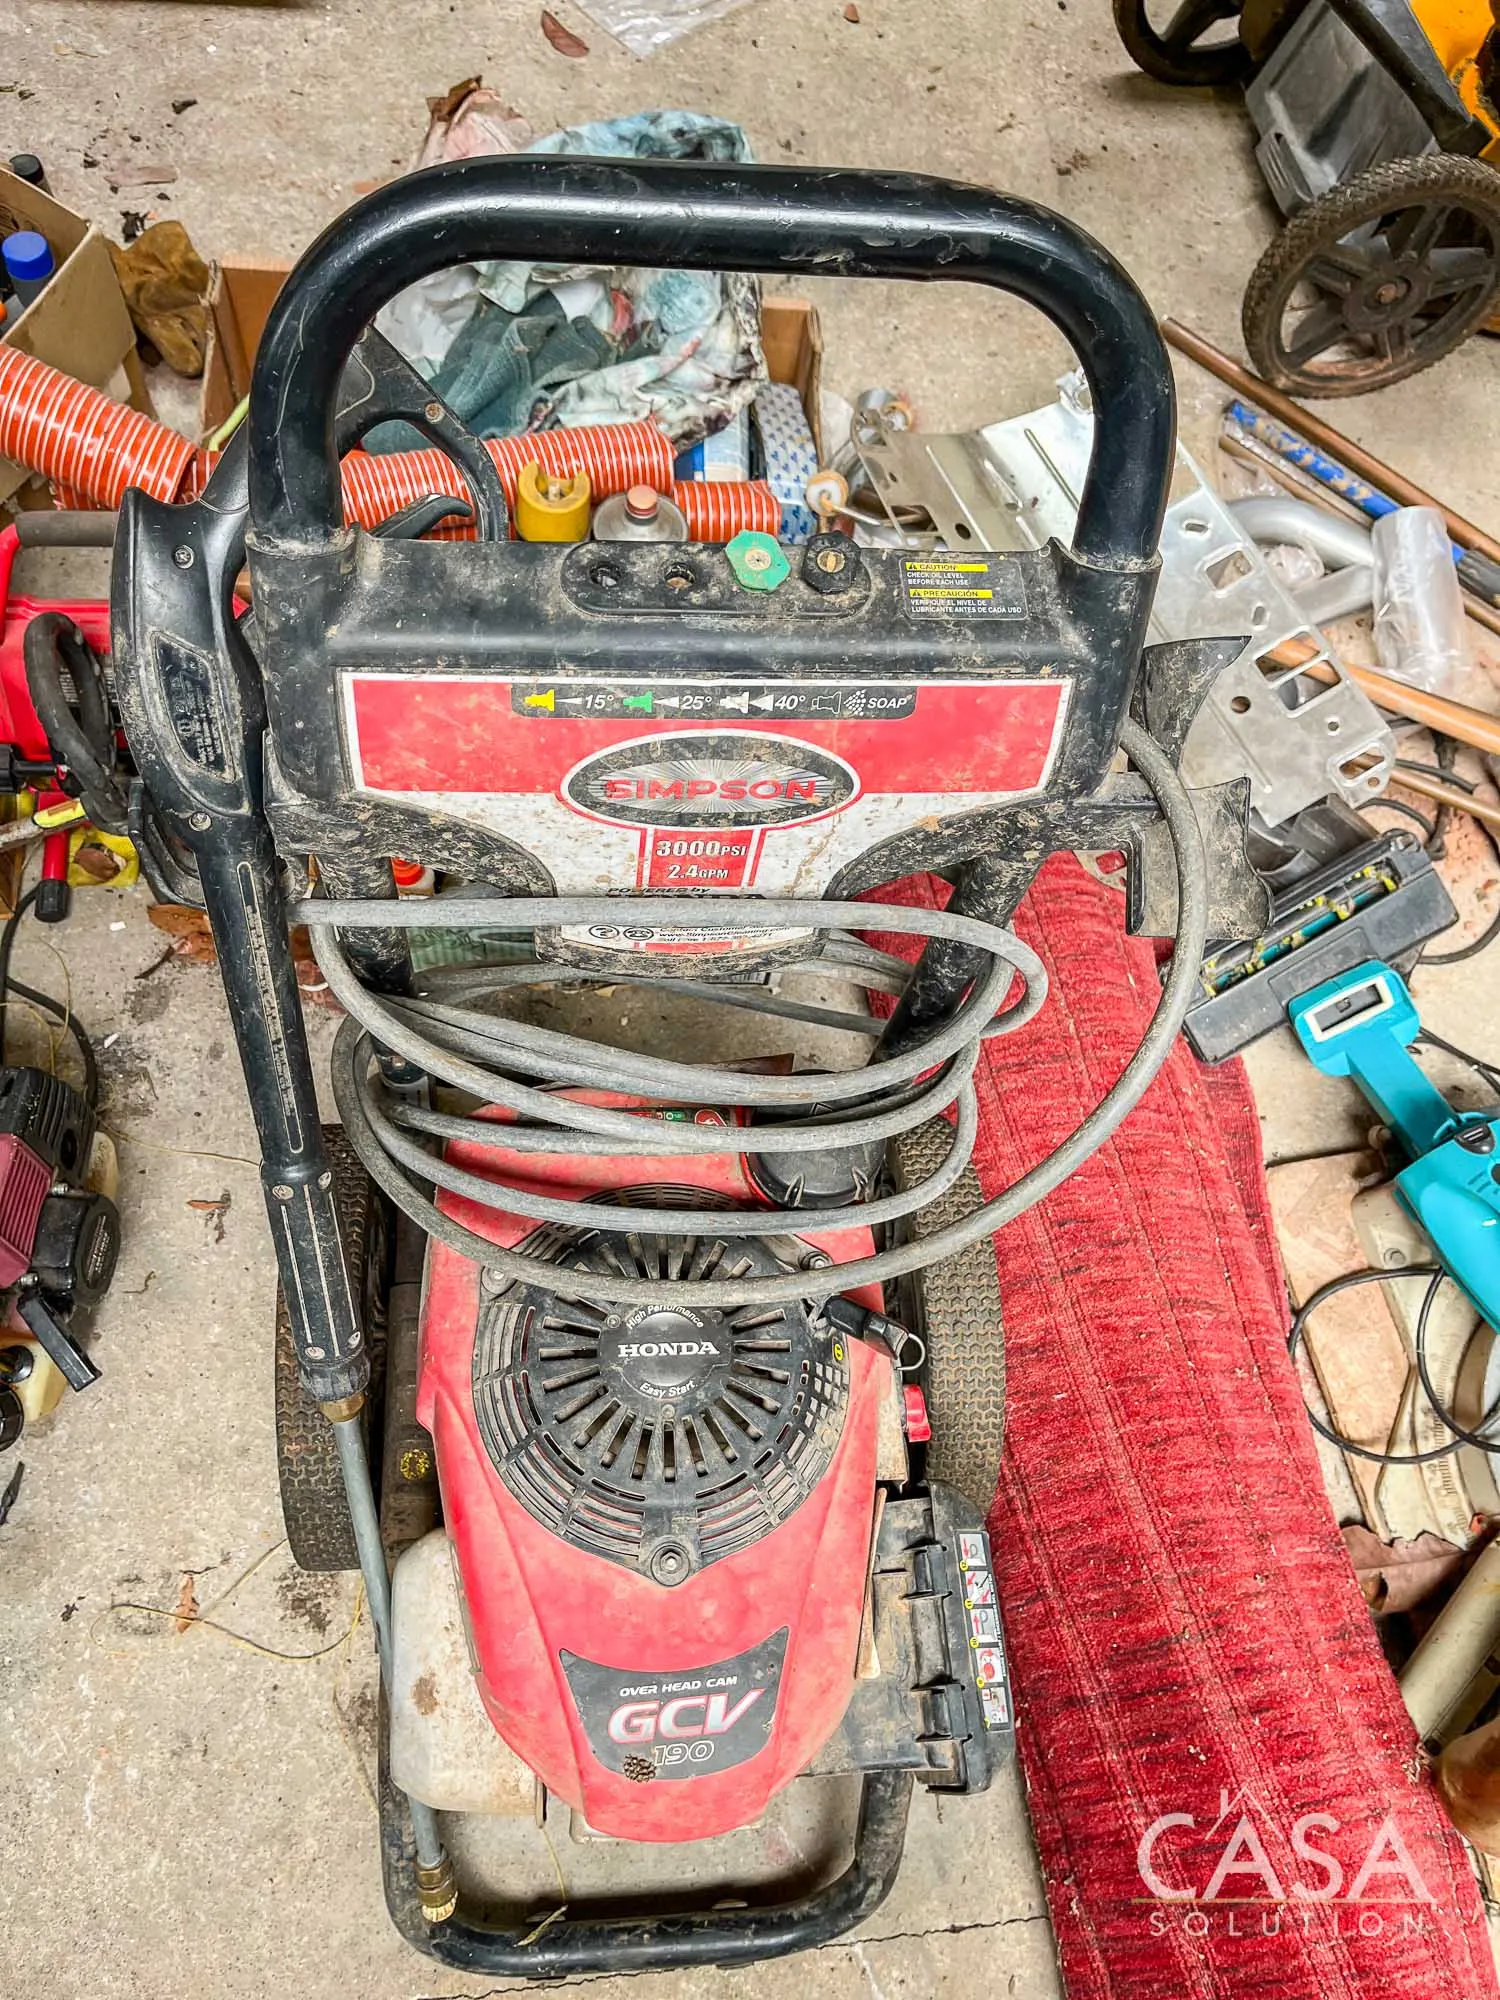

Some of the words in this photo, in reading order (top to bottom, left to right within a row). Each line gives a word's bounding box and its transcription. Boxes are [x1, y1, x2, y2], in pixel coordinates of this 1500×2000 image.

[923, 589, 978, 597] PRECAUCIÓN
[584, 694, 614, 709] 15°
[682, 695, 712, 710] 25°
[775, 694, 806, 710] 40°
[867, 697, 907, 709] SOAP
[603, 778, 816, 800] SIMPSON
[626, 1310, 646, 1329] High
[648, 1304, 704, 1328] Performance
[617, 1341, 720, 1358] HONDA
[639, 1382, 666, 1397] Easy
[619, 1685, 658, 1698] OVER
[661, 1680, 702, 1694] HEAD
[706, 1675, 738, 1688] CAM
[607, 1687, 767, 1744] GCV
[653, 1739, 715, 1767] 190
